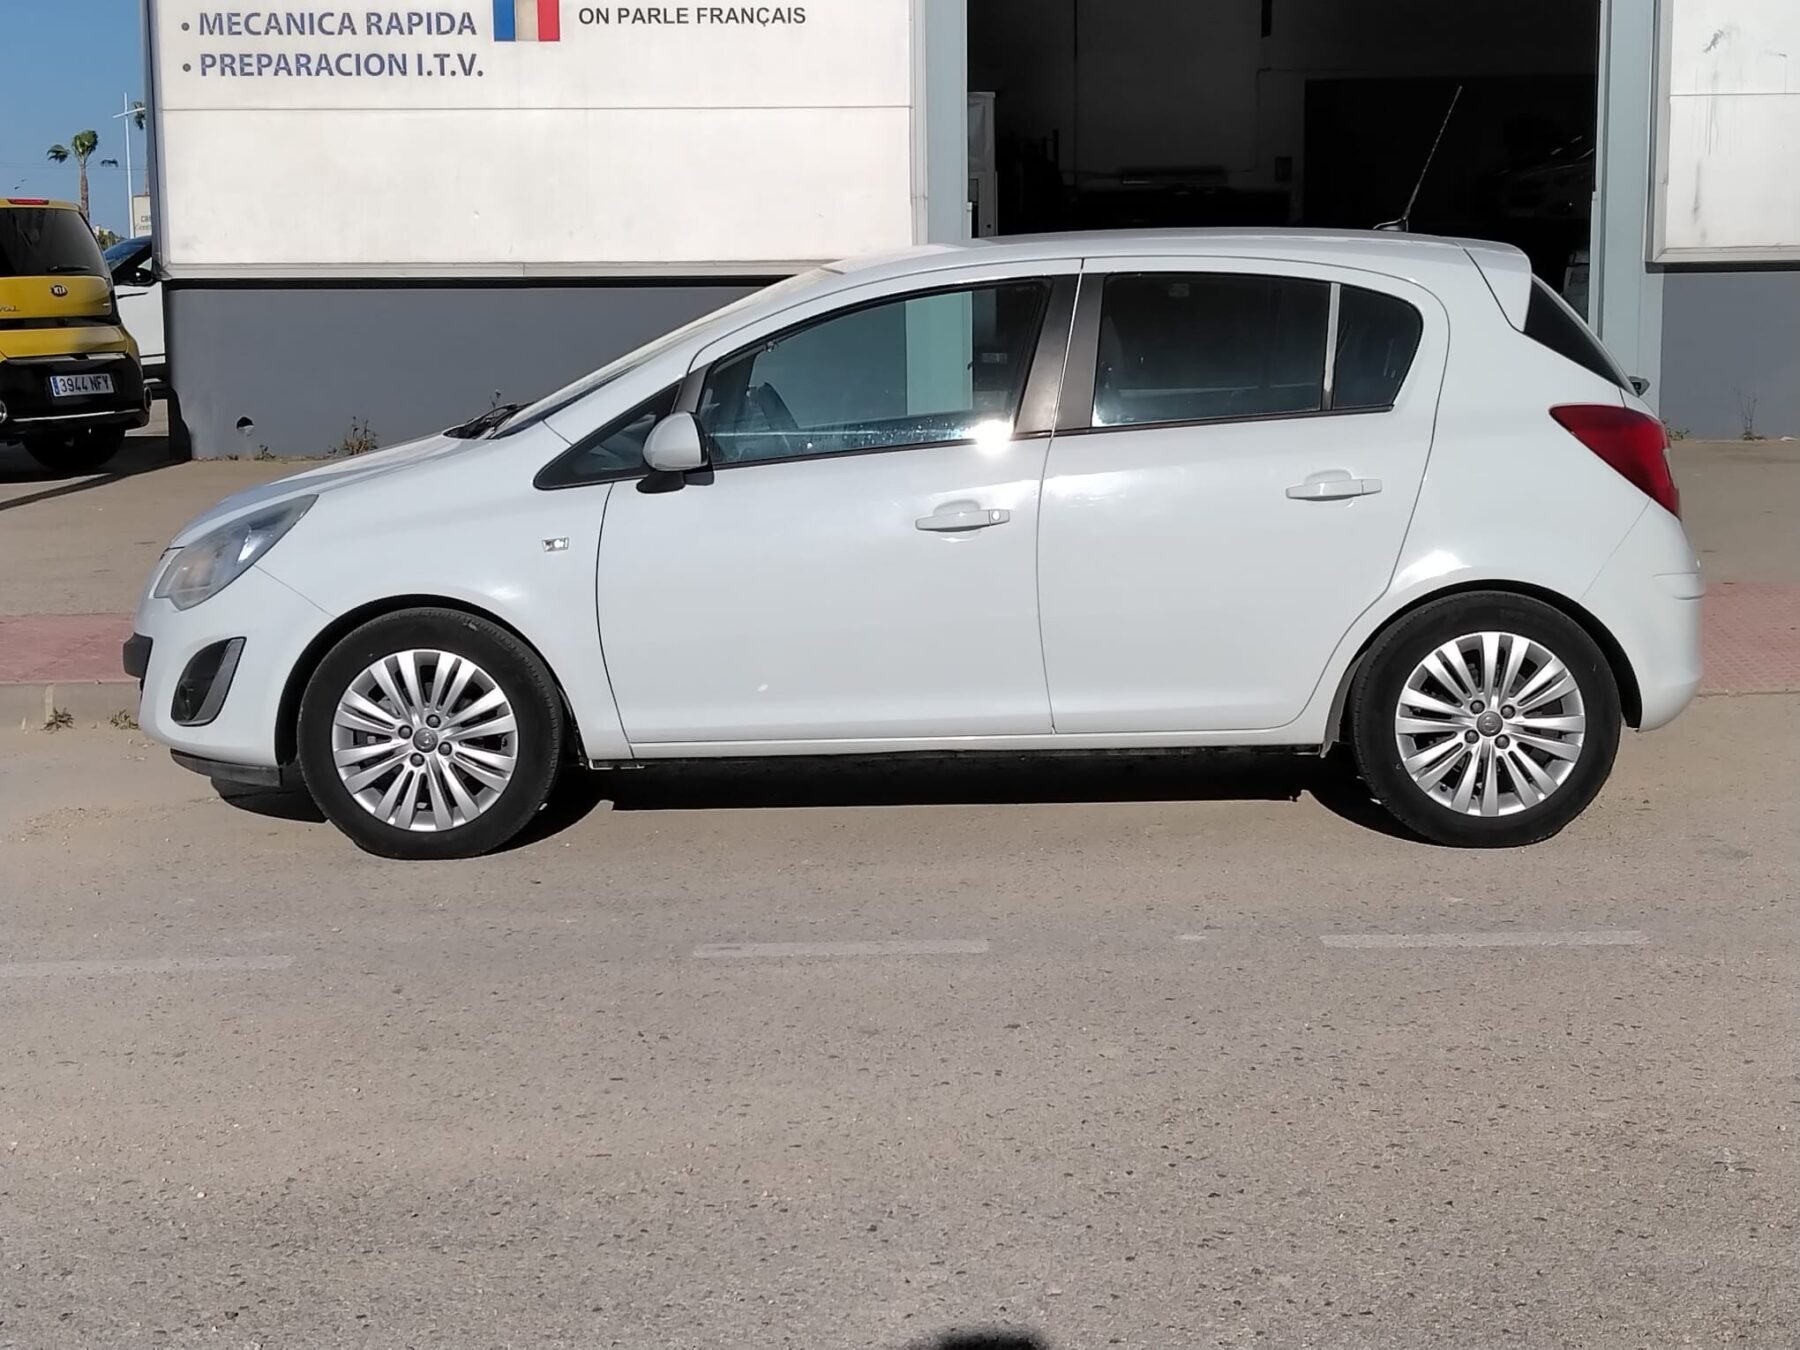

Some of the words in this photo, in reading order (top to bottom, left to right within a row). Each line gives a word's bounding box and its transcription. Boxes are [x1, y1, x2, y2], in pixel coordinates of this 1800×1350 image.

[199, 12, 357, 36] MECANICA
[366, 12, 478, 36] RAPIDA
[578, 7, 610, 25] ON
[617, 7, 689, 25] PARLE
[696, 6, 807, 27] FRANÇAIS
[200, 53, 407, 77] PREPARACION
[416, 53, 484, 77] I.T.V.
[59, 376, 88, 393] 3944
[89, 375, 109, 391] NFY
